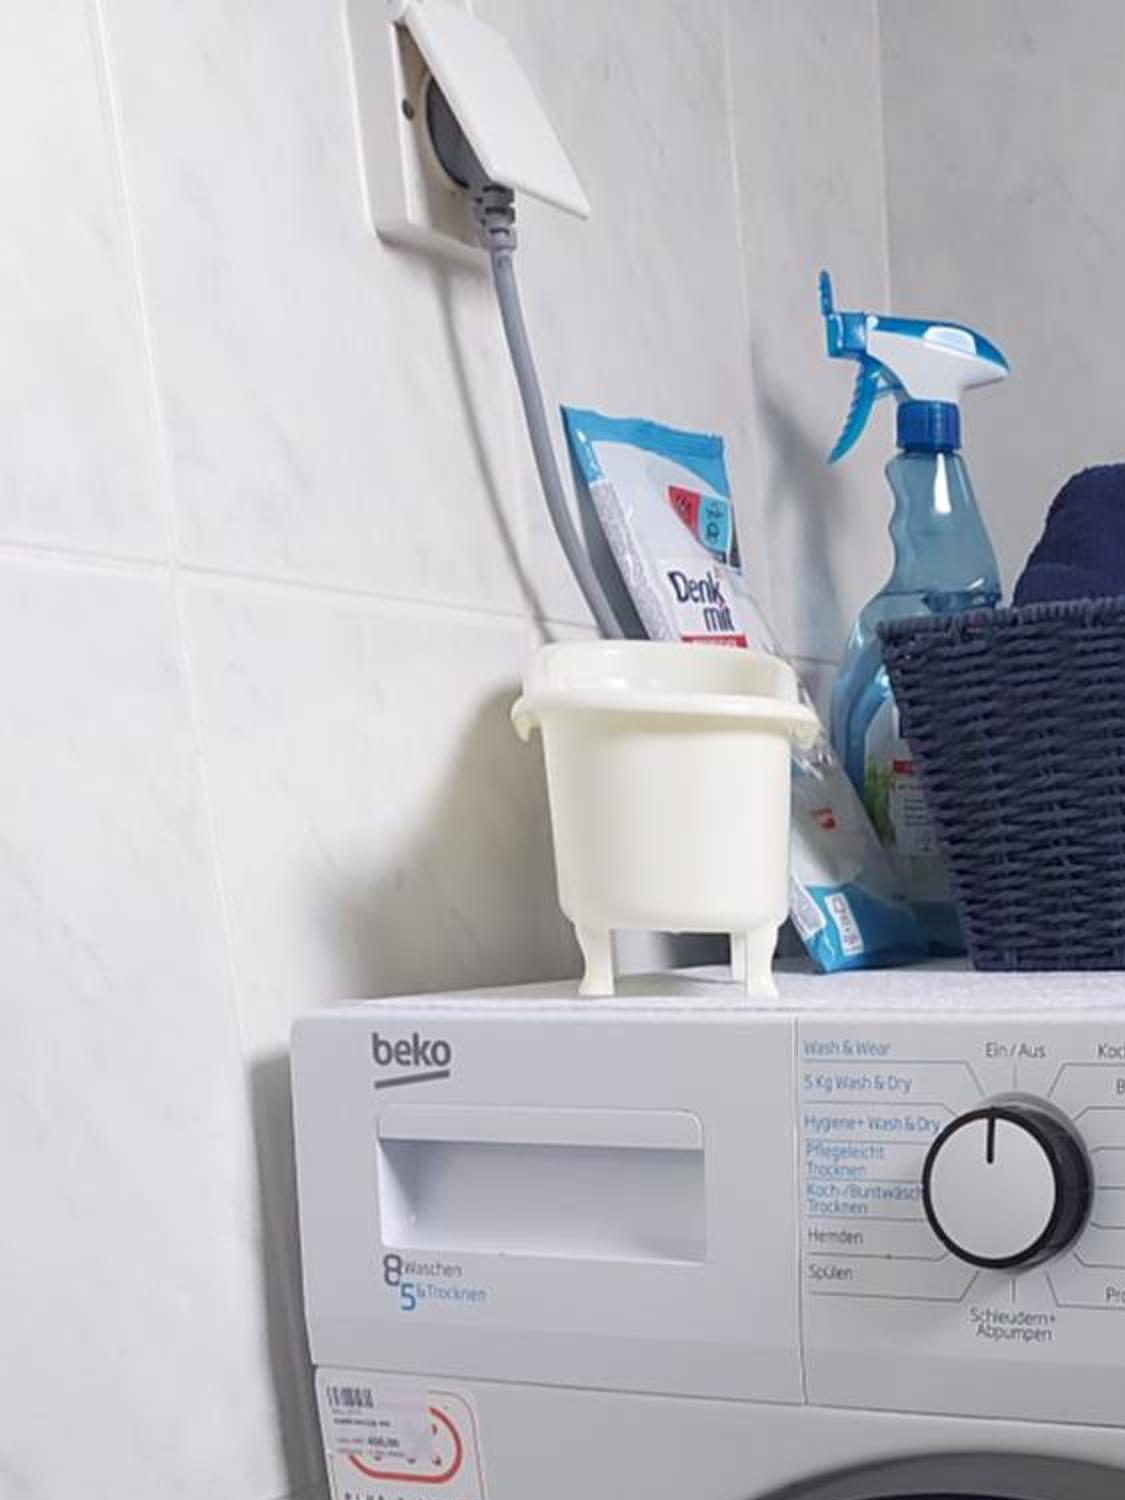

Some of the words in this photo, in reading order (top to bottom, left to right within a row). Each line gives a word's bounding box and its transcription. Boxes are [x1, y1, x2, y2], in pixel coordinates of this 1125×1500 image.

[667, 570, 726, 604] Denk
[372, 1032, 452, 1067] beko
[803, 1039, 840, 1056] Wash
[842, 1039, 853, 1056] &
[855, 1040, 891, 1056] Wear
[986, 1043, 1009, 1058] Ein
[1018, 1043, 1047, 1058] Aus
[804, 1073, 813, 1089] 5
[815, 1073, 833, 1092] Kg
[834, 1074, 872, 1090] Wash
[874, 1075, 885, 1090] &
[888, 1075, 914, 1094] Dry
[867, 1117, 903, 1132] Wash
[917, 1119, 942, 1136] Dry
[805, 1141, 885, 1162] Pflegeleicht
[808, 1162, 866, 1178] Trocknen
[807, 1183, 922, 1201] Koch-/Buntwäsch
[808, 1199, 868, 1215] Trocknen
[808, 1227, 864, 1245] Hemden
[383, 1253, 403, 1288] 8
[404, 1261, 464, 1279] Waschen
[808, 1263, 853, 1281] Spülen
[400, 1282, 418, 1313] 5
[427, 1284, 487, 1303] Trocknen
[970, 1307, 1056, 1326] Schleudern+
[975, 1323, 1053, 1343] Abpumpen
